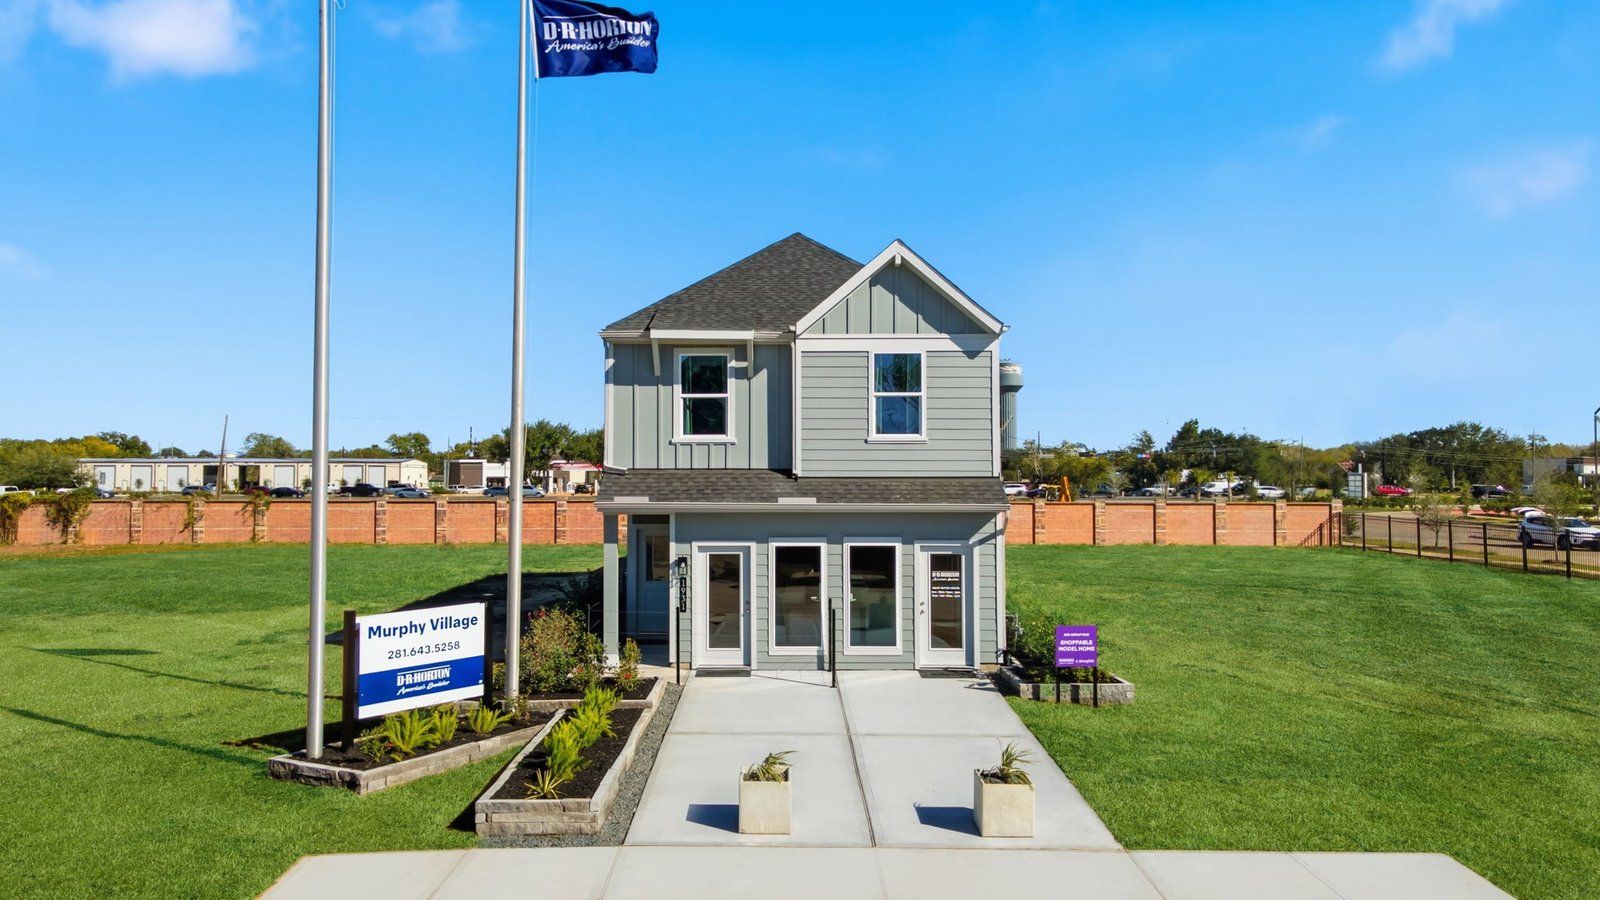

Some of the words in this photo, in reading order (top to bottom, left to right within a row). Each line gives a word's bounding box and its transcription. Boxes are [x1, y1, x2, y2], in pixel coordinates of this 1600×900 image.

[544, 39, 604, 53] America's
[607, 36, 651, 50] Builder
[367, 620, 426, 639] Murphy
[430, 616, 478, 631] Village
[387, 640, 460, 660] 281.643.5258
